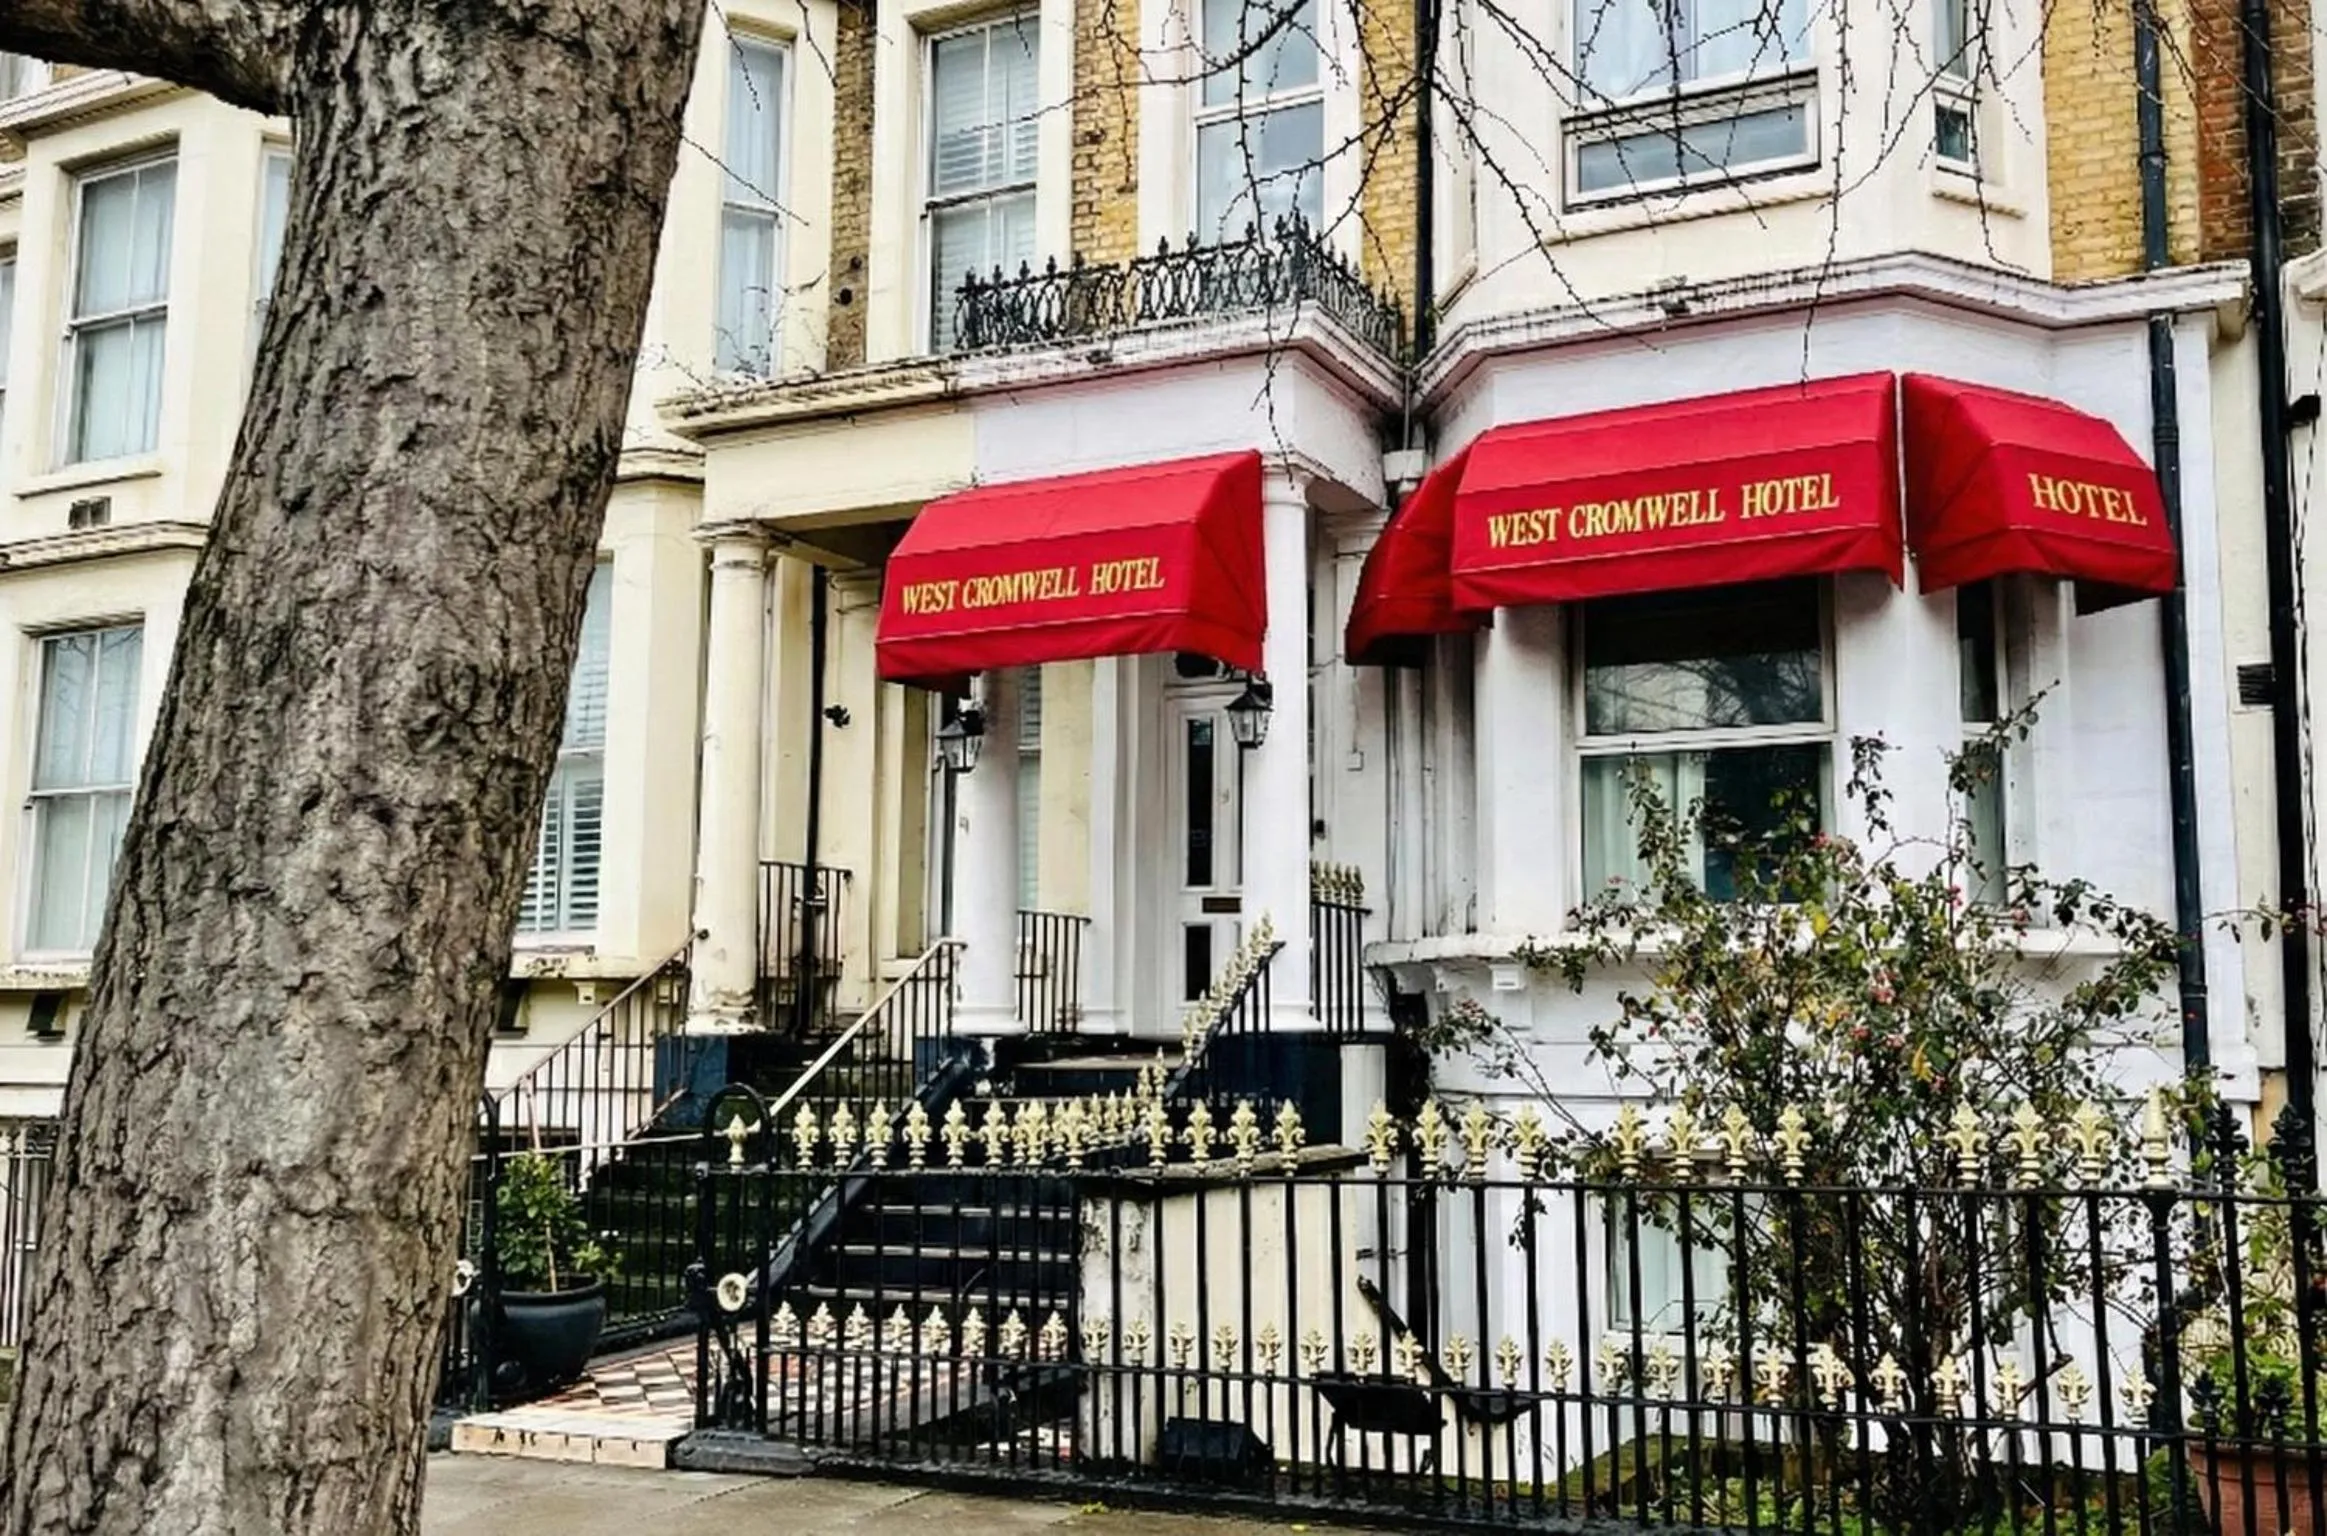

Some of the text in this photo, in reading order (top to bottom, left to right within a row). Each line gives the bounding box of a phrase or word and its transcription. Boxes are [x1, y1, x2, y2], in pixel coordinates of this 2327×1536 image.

[1488, 472, 1840, 548] WEST CROMWELL HOTEL
[2028, 472, 2147, 526] HOTEL
[902, 556, 1165, 613] WEST CROMWELL HOTEL
